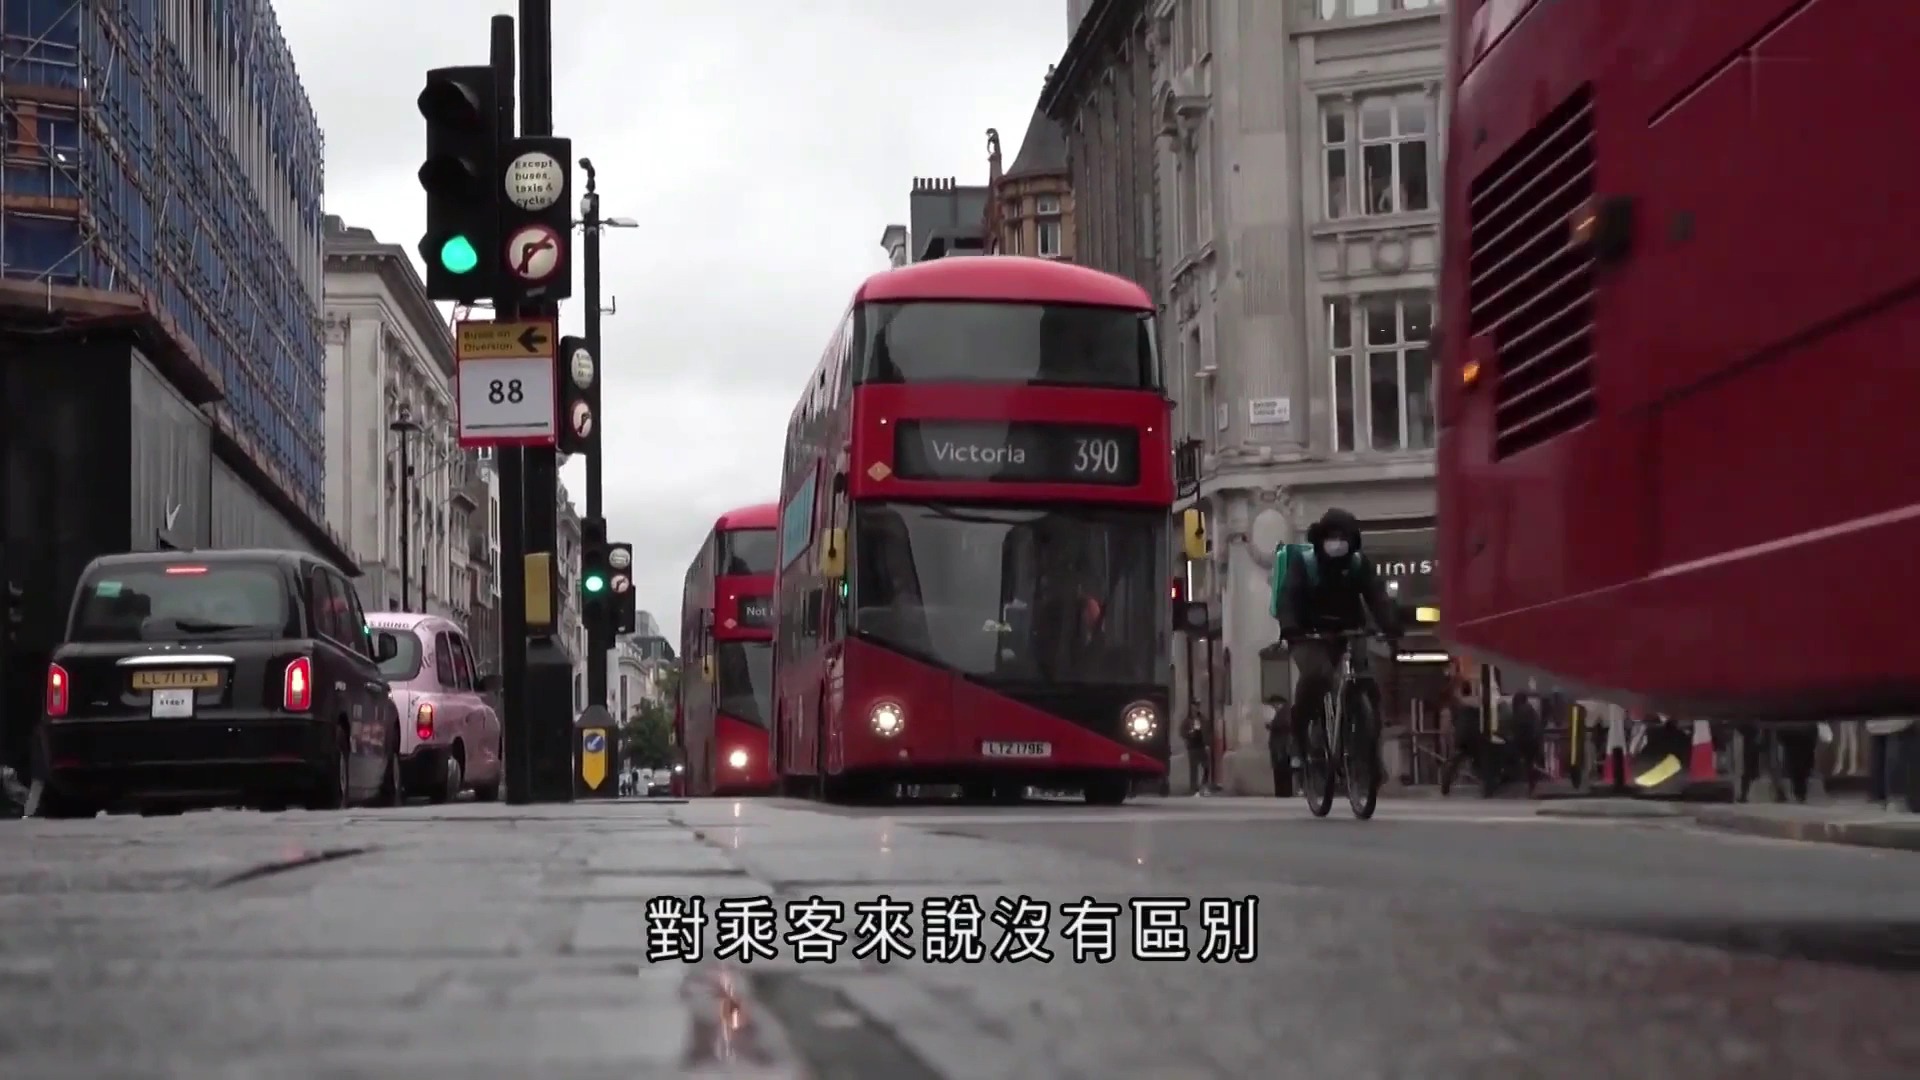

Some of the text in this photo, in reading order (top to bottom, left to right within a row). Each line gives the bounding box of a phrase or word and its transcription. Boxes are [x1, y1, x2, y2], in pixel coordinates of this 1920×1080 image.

[515, 160, 553, 169] Except
[516, 182, 553, 193] taxis &
[464, 343, 513, 352] Diversion
[488, 379, 523, 404] 88
[931, 438, 1119, 474] Victoria 390
[746, 605, 767, 616] Not
